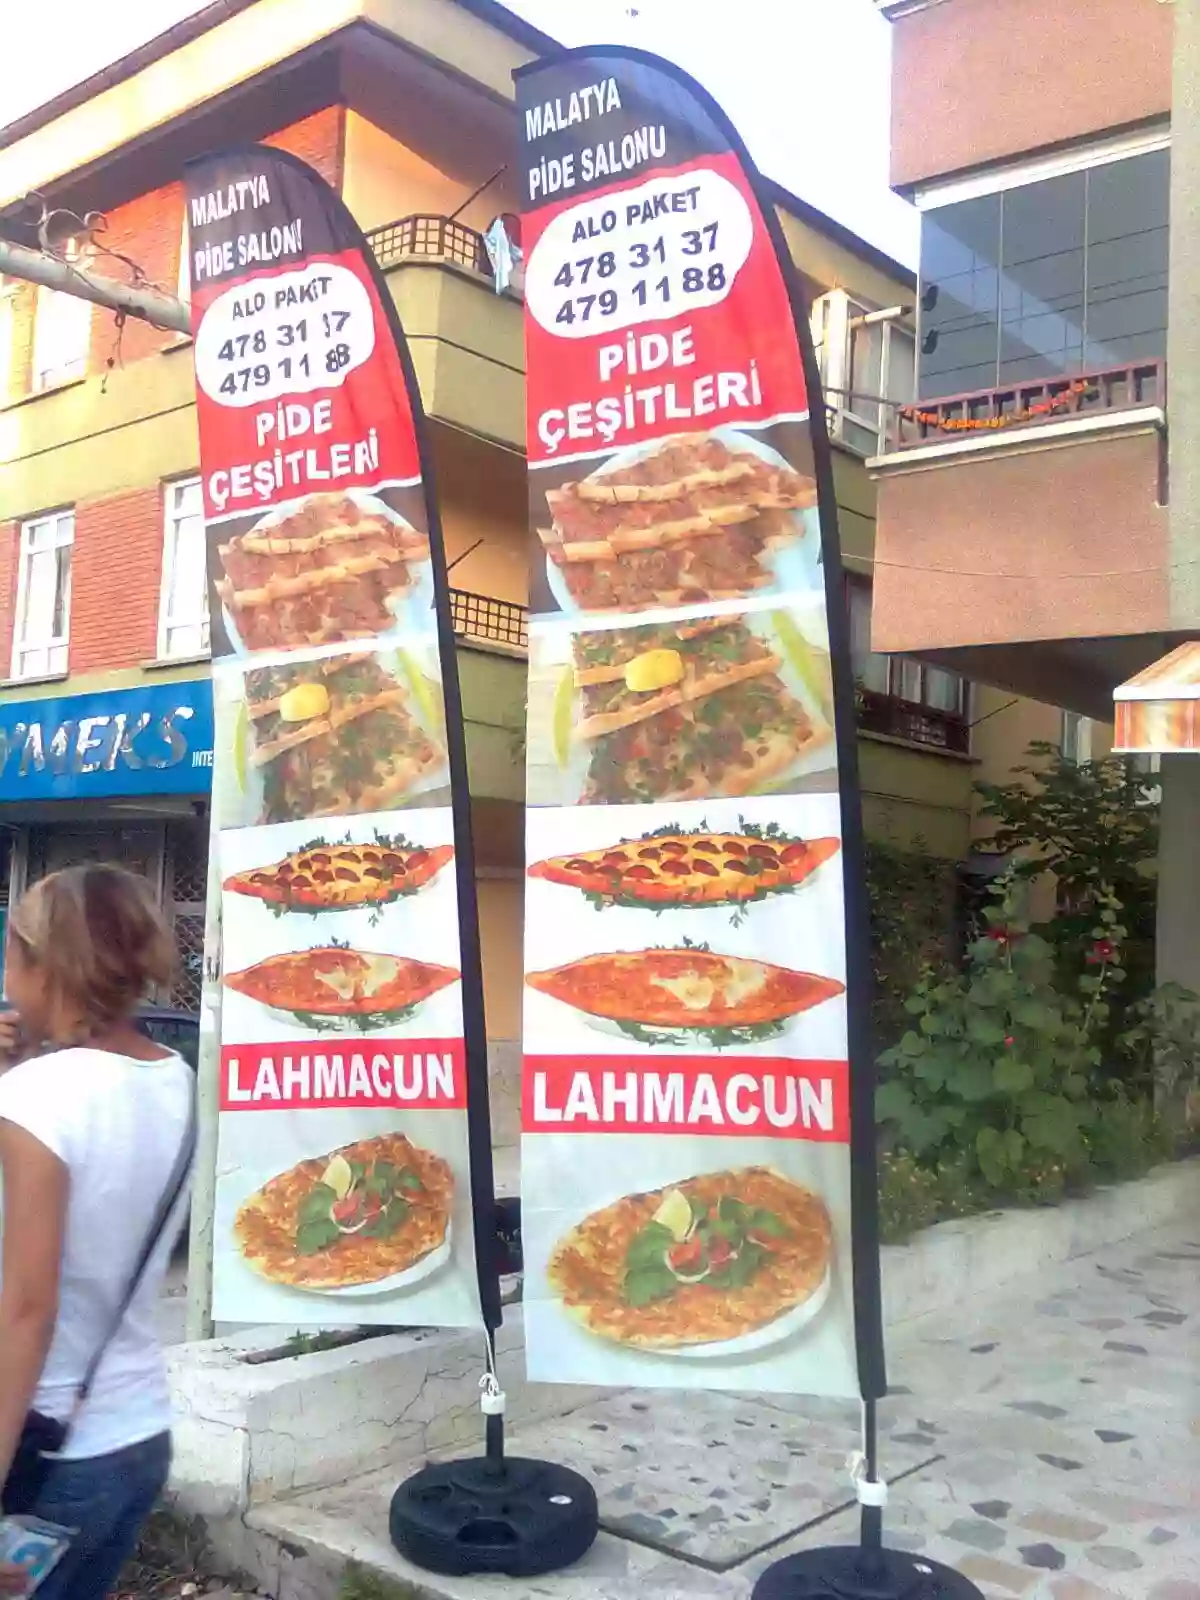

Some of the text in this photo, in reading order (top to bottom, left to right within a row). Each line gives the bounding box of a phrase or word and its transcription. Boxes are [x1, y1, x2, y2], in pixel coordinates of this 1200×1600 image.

[525, 76, 622, 142] MALATYA
[528, 124, 667, 202] PİDE SALONU
[191, 174, 270, 227] MALATYA
[571, 186, 701, 243] ALO PAKET
[194, 241, 235, 281] PİDE
[554, 222, 720, 289] 478 31 37
[232, 276, 333, 321] ALO PAKT
[555, 262, 727, 326] 479 11 88
[218, 329, 267, 362] 478
[276, 319, 308, 347] 31
[219, 343, 351, 395] 479 11 88
[599, 325, 697, 382] PİDE
[256, 399, 333, 447] PİDE
[537, 359, 763, 454] ÇEŞİTLERİ
[208, 427, 379, 511] ÇEŞİTLERİ
[227, 1053, 456, 1102] LAHMACUN
[532, 1071, 834, 1131] LAHMACUN
